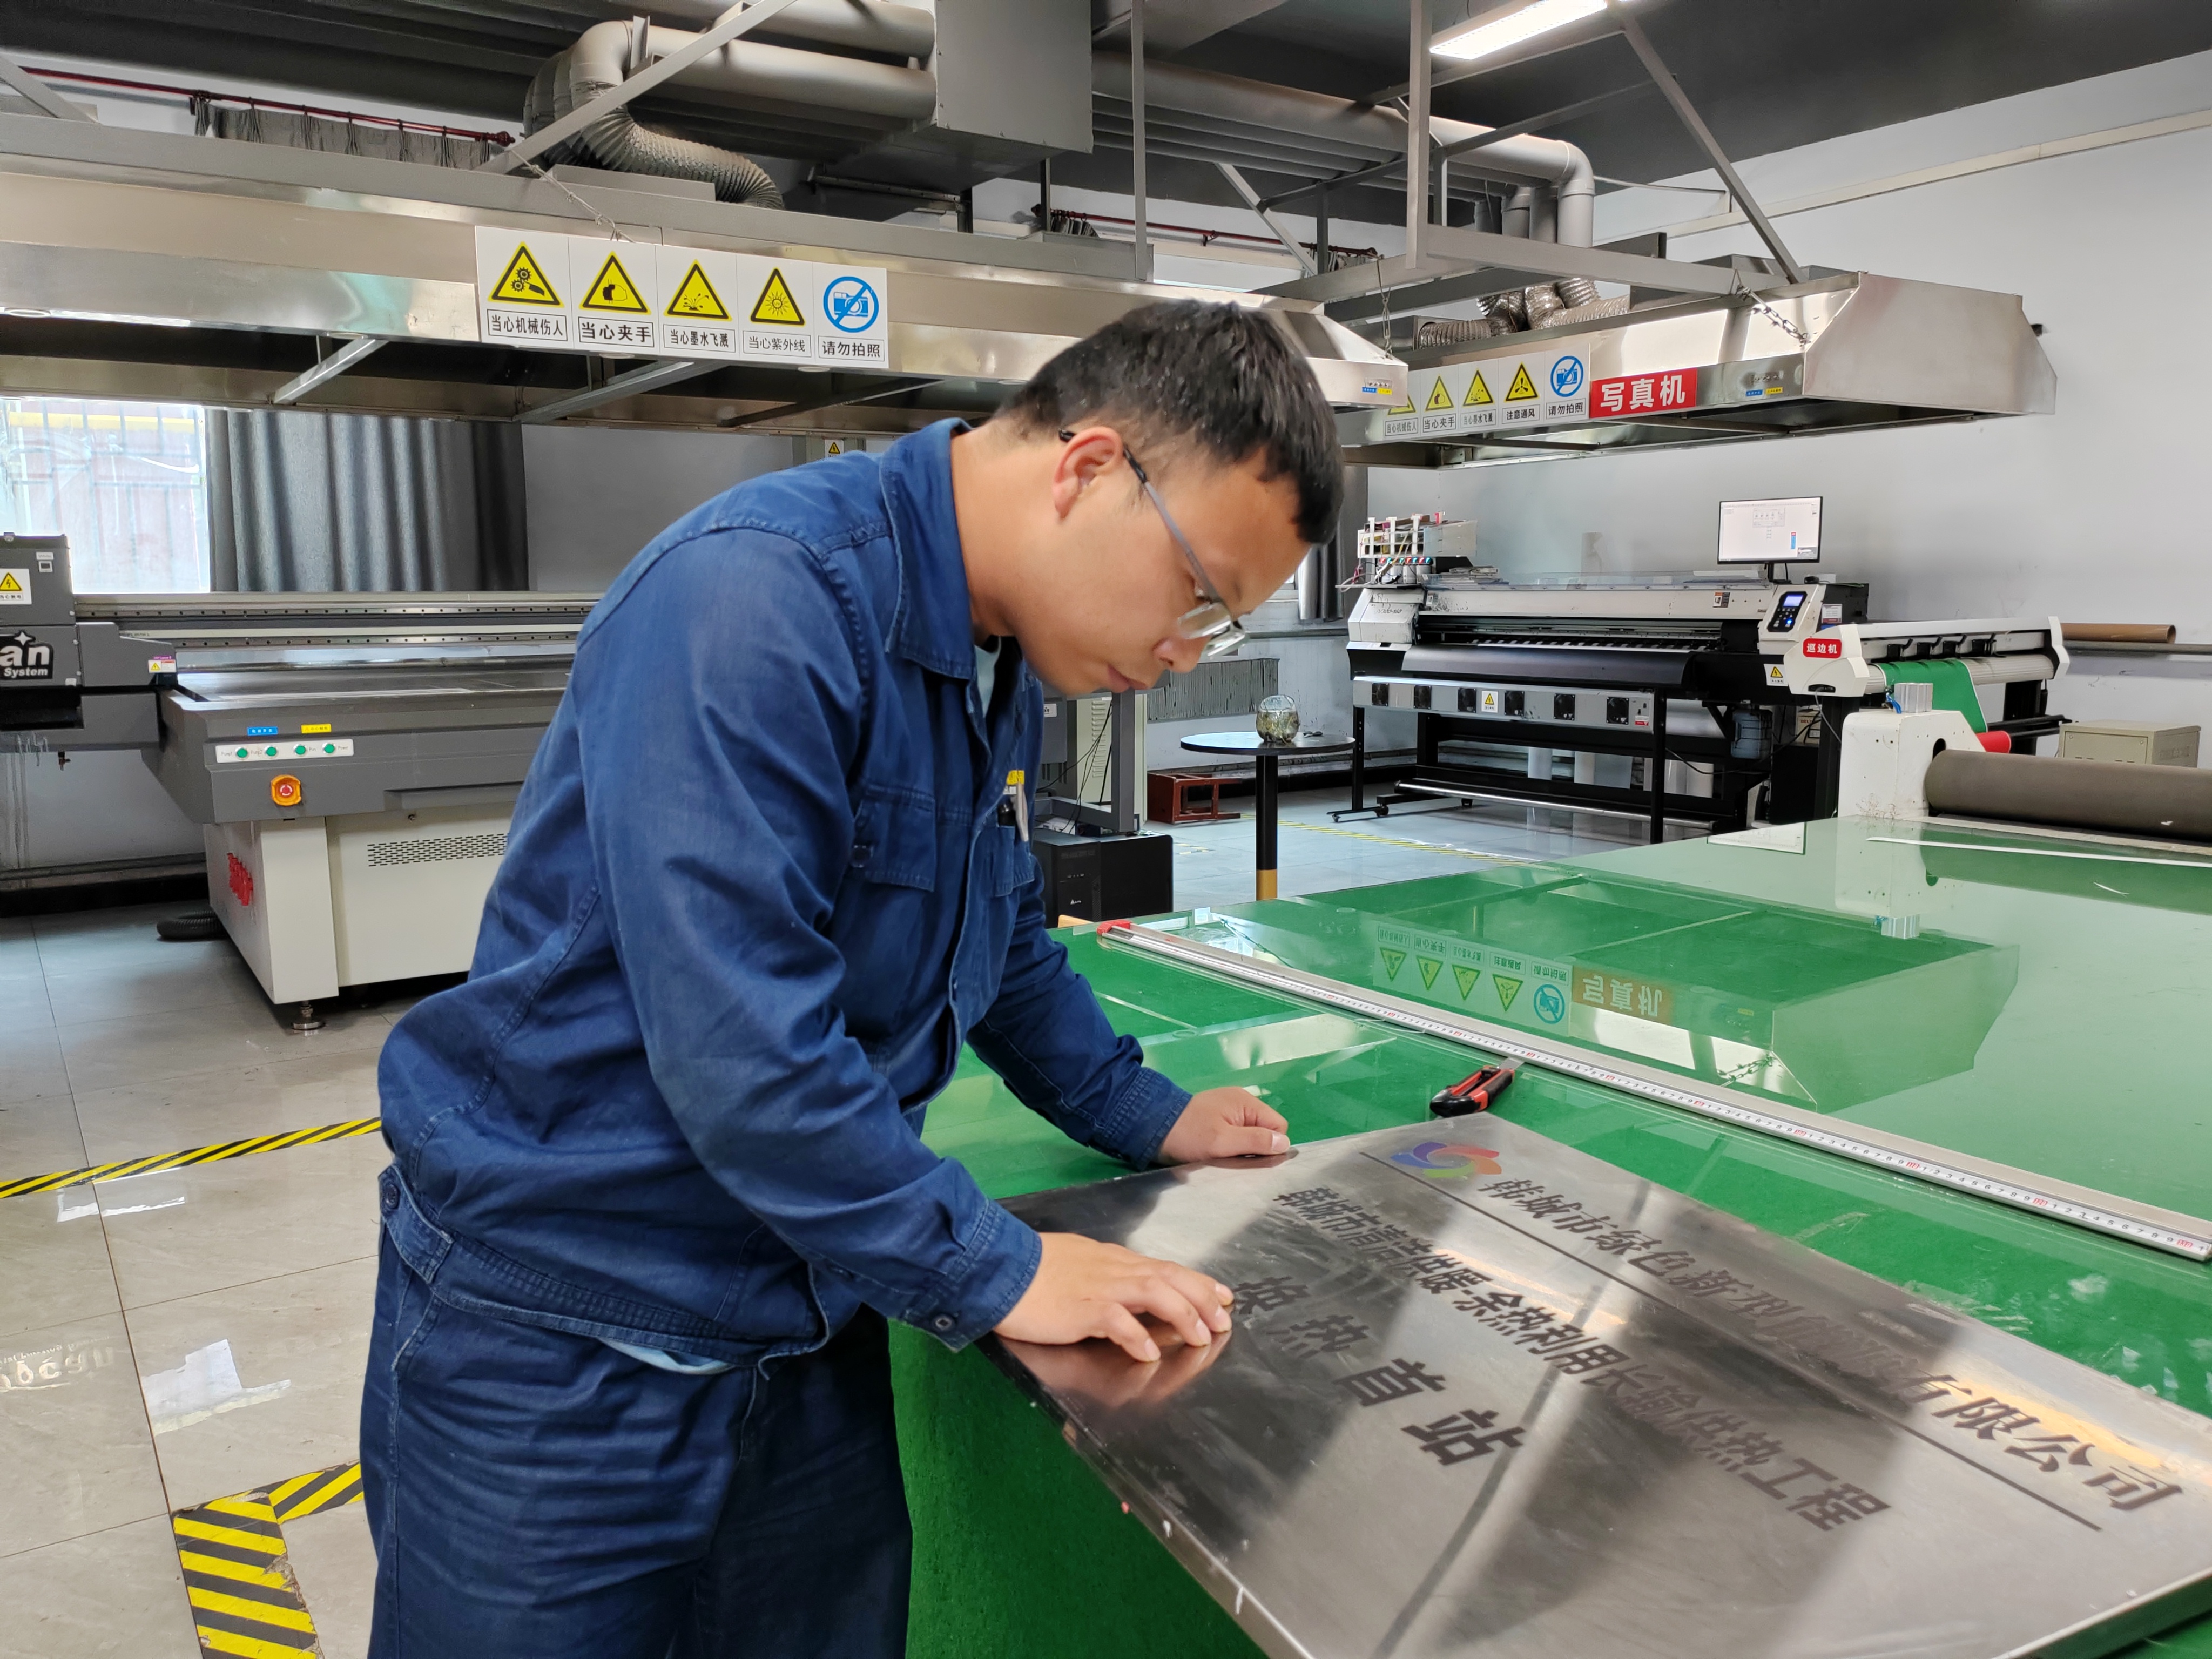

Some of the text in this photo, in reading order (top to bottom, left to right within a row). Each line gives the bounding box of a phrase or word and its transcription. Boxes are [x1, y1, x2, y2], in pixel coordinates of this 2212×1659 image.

[491, 314, 563, 336] 当心机械伤人
[582, 321, 651, 343] 当心夹手
[670, 329, 729, 348] 当心墨水飞溅
[748, 335, 806, 352] 当心紫外线
[821, 341, 881, 358] 请勿拍照
[1600, 375, 1685, 412] 写真机
[1507, 408, 1535, 420] 注意通风
[1548, 402, 1583, 416] 请勿拍照
[1387, 423, 1417, 434] 当心机械伤人
[1424, 416, 1455, 430] 当心夹手
[1806, 643, 1838, 654] 巡边机
[4, 667, 48, 679] System
[1477, 1178, 2183, 1511] 韩城市绿色新型有限公司
